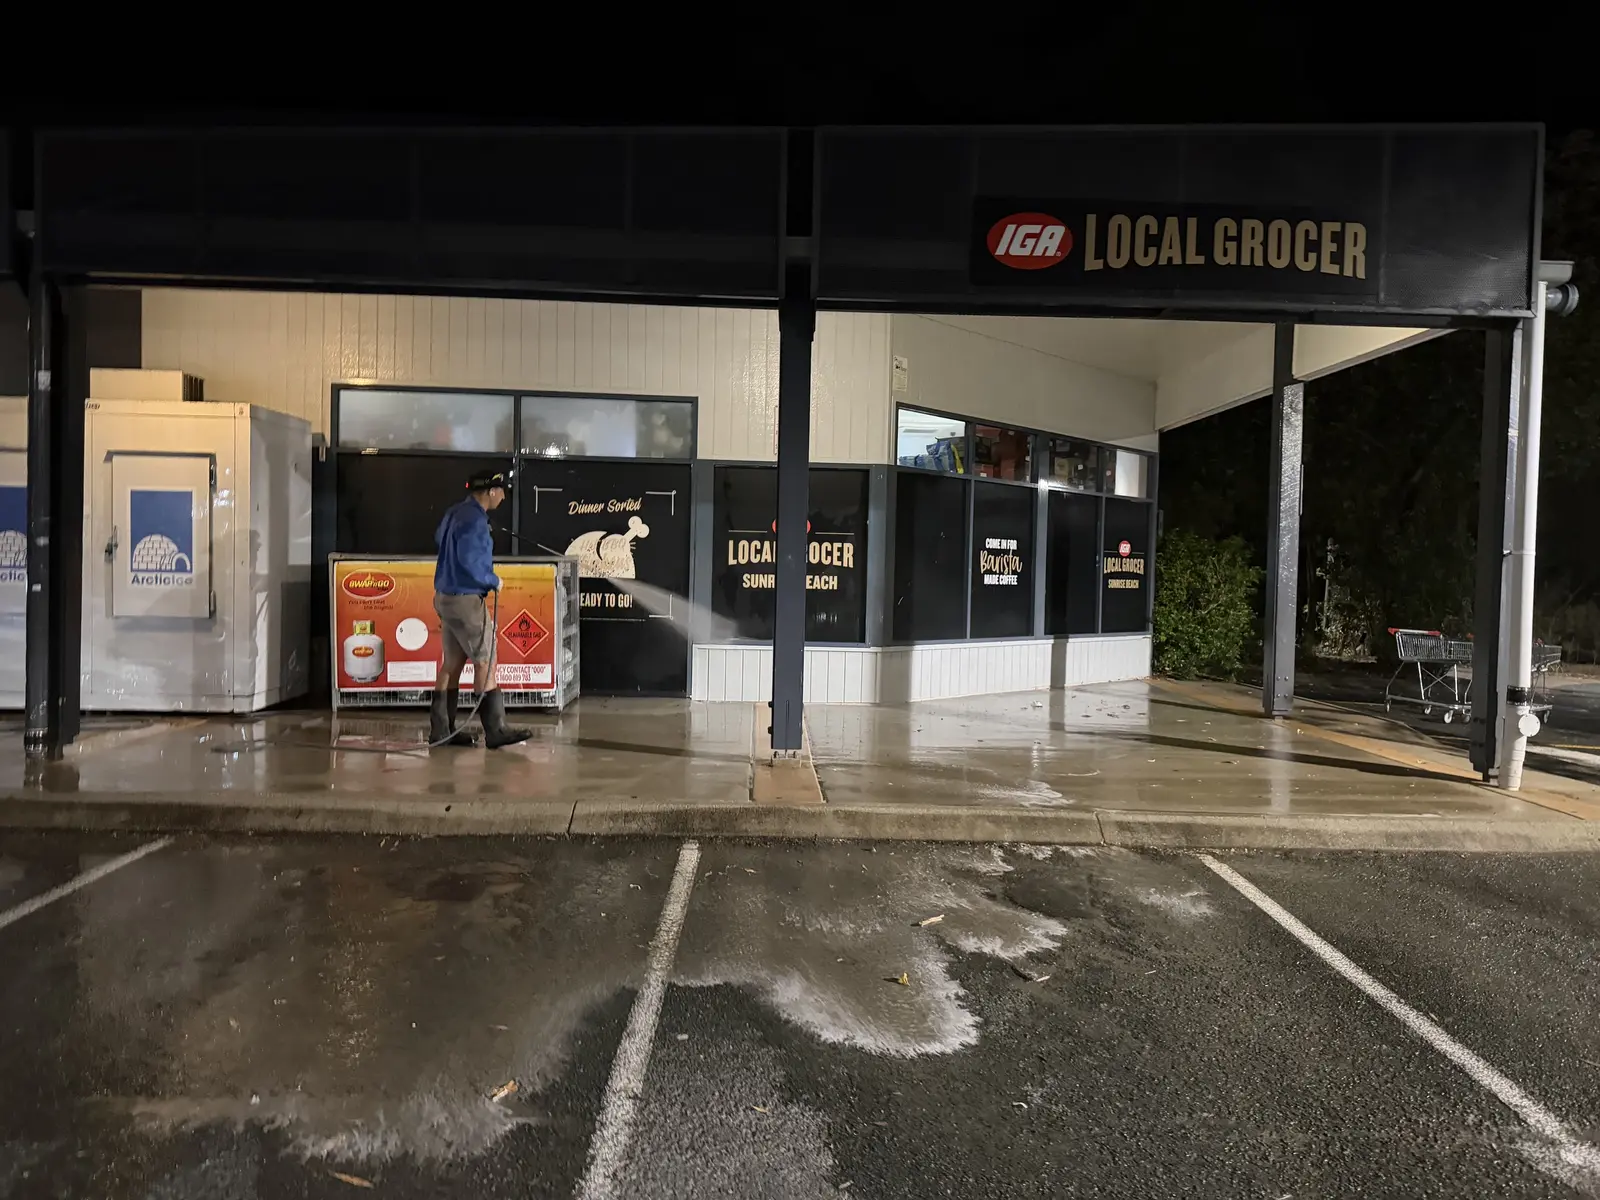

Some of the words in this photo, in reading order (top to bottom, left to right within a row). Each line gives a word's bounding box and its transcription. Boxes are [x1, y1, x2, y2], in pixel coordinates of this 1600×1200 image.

[994, 224, 1066, 257] IGA
[1084, 213, 1205, 271] LOCAL
[1213, 217, 1367, 280] GROCER
[567, 499, 605, 516] Dinner
[607, 497, 643, 513] Sorted
[985, 537, 1001, 549] COME
[1001, 538, 1007, 550] IN
[1007, 539, 1018, 550] FOR
[806, 541, 854, 568] OCER
[980, 549, 1023, 575] Barista
[1103, 556, 1122, 574] LOCAL
[1122, 557, 1145, 575] GROCER
[742, 573, 776, 589] SUNR
[806, 574, 838, 590] EACH
[984, 574, 1000, 585] MADE
[1000, 574, 1018, 585] COFFEE
[1108, 578, 1126, 588] SUNRISE
[1126, 579, 1139, 588] BEACH
[580, 592, 603, 607] EADY
[604, 594, 616, 607] TO
[617, 594, 633, 608] GO!
[522, 640, 527, 648] 2
[506, 666, 531, 674] CONTACT
